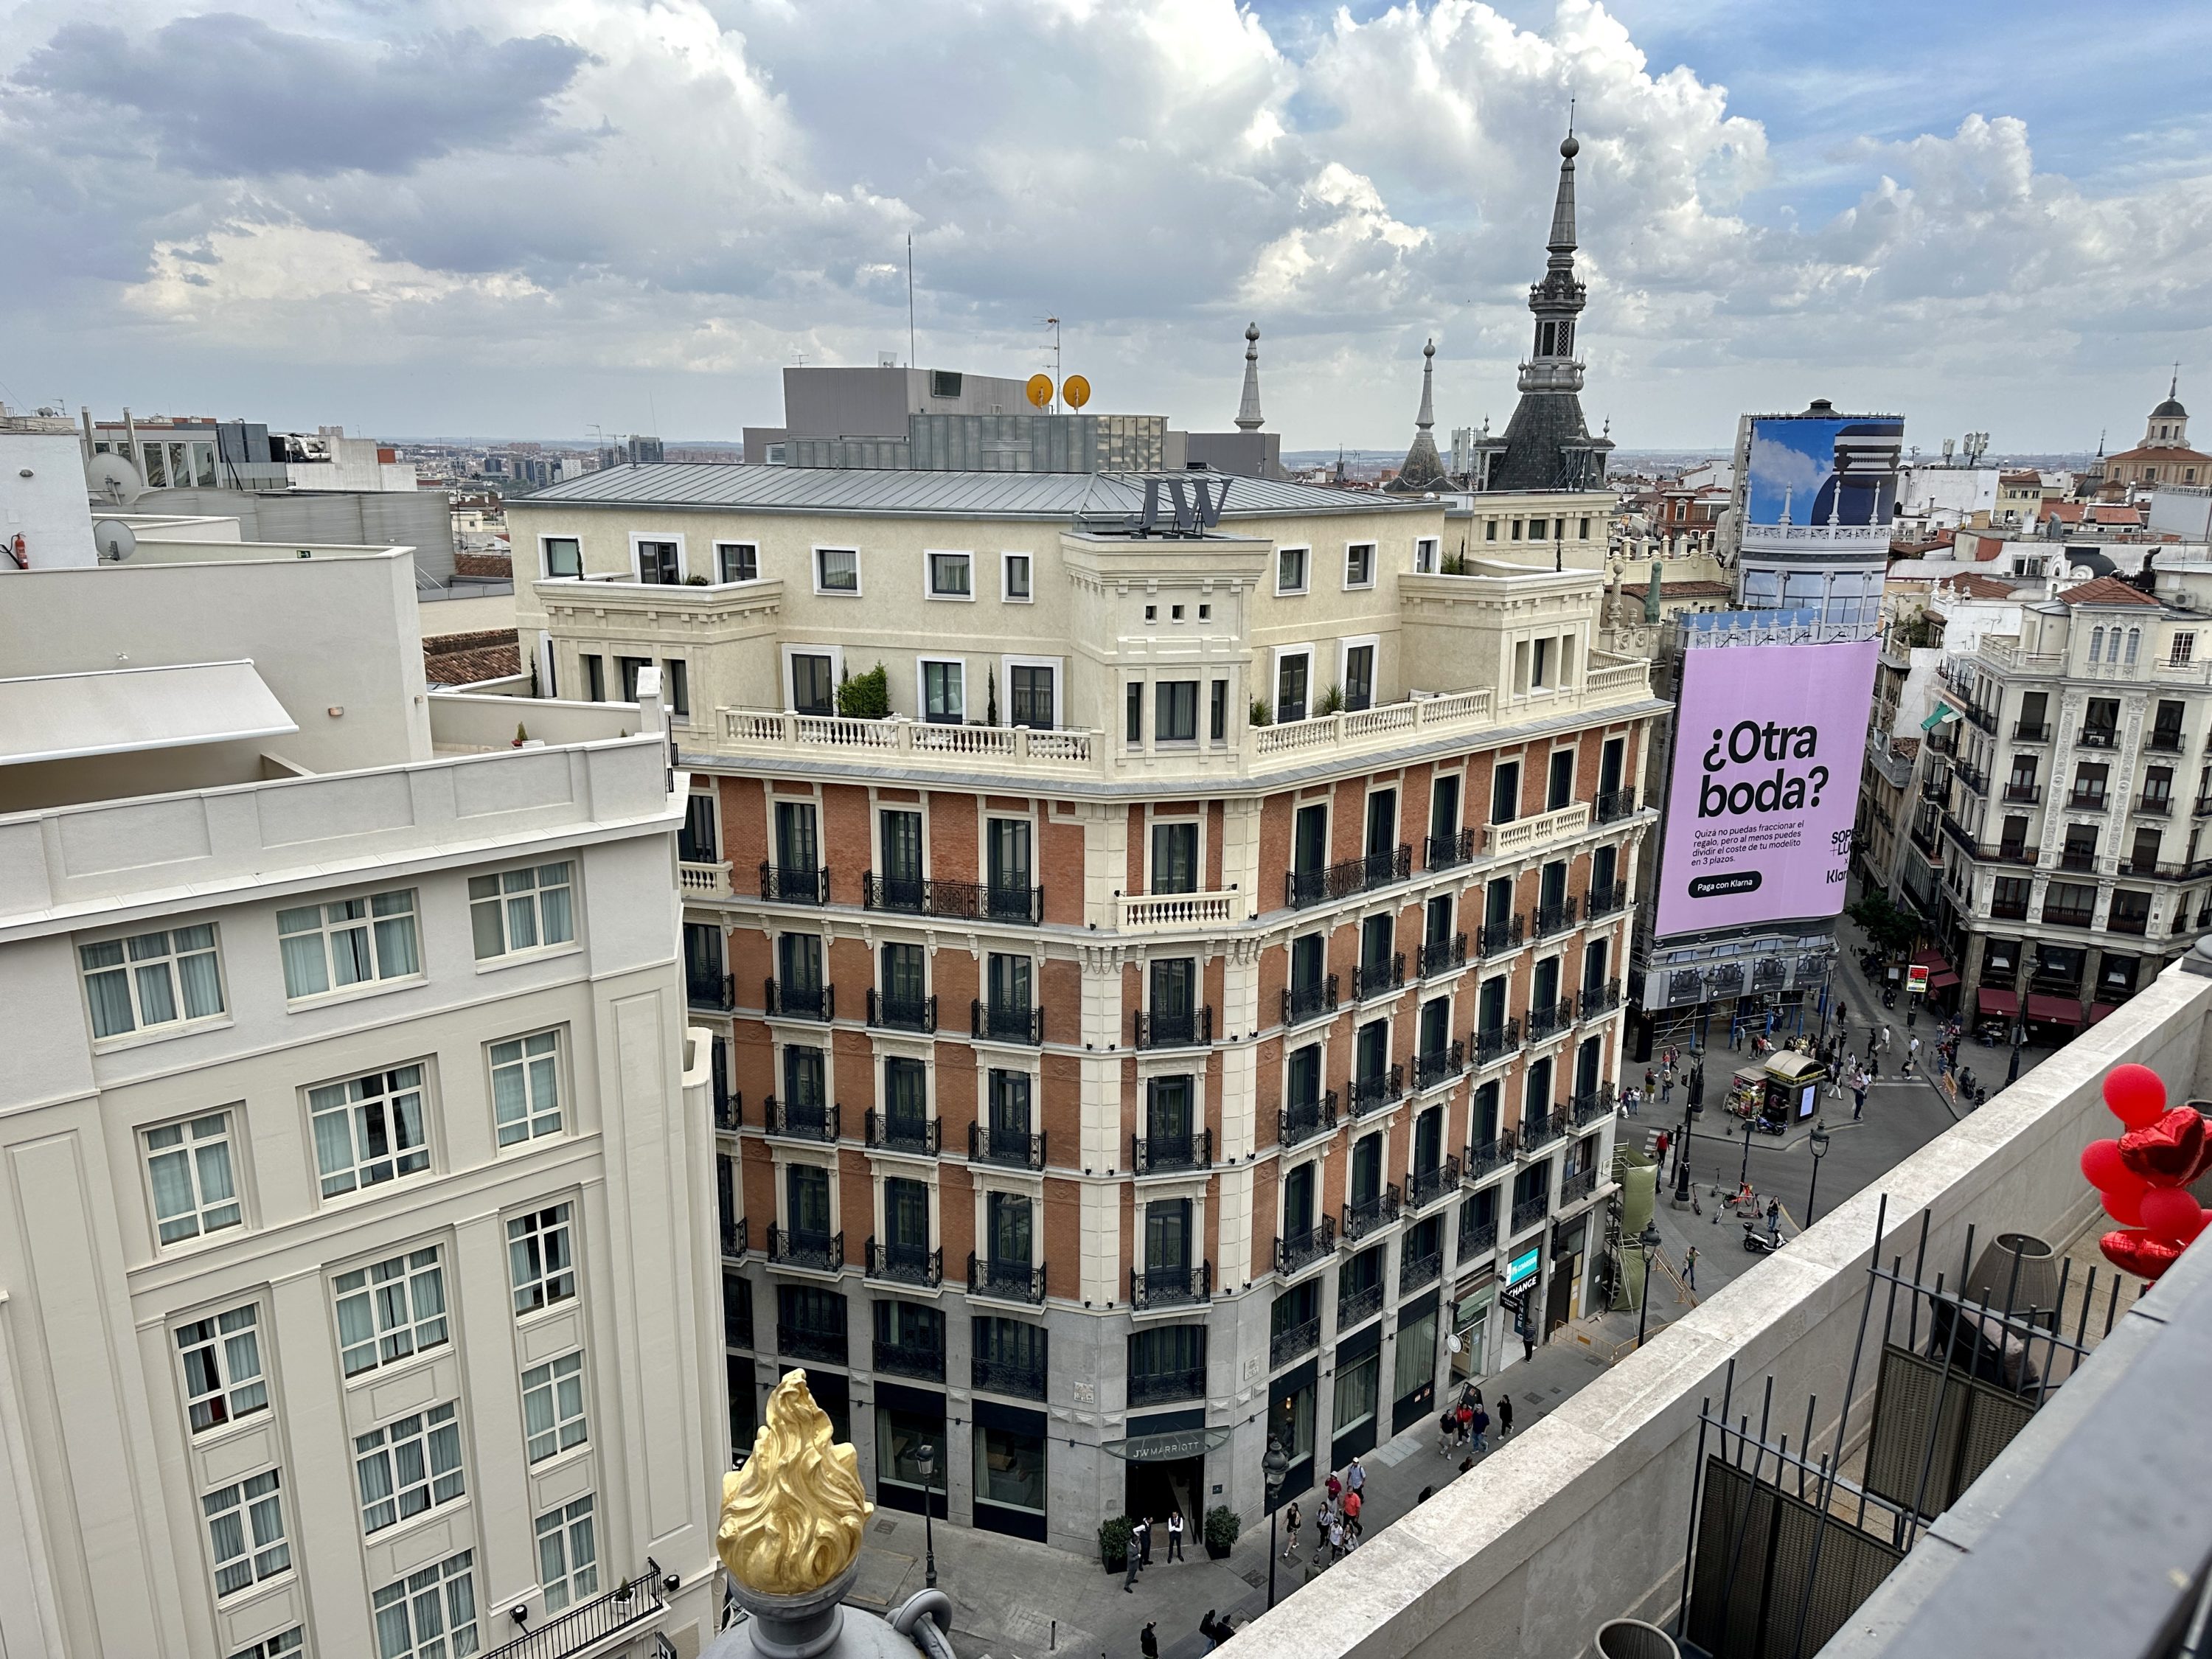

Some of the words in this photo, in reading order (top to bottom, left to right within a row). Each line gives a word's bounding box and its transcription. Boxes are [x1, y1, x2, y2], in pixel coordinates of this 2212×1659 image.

[1123, 479, 1235, 529] JW
[1703, 720, 1818, 772] ¿Otra
[1697, 765, 1829, 818] boda?
[1694, 829, 1717, 839] Quizá
[1729, 825, 1757, 836] puedas
[1759, 821, 1796, 832] fraccionar
[1797, 820, 1804, 828] el
[1692, 847, 1716, 857] dividir
[1717, 846, 1724, 855] el
[1725, 844, 1746, 853] coste
[1747, 843, 1758, 851] de
[1769, 839, 1801, 849] modelito
[1693, 838, 1719, 849] regalo,
[1721, 837, 1739, 846] pero
[1739, 835, 1747, 843] al
[1748, 832, 1773, 841] menos
[1774, 830, 1801, 841] puedes
[1691, 858, 1701, 866] en
[1703, 857, 1708, 865] 3
[1709, 855, 1736, 866] plazos.
[1697, 883, 1714, 892] Paga
[1716, 881, 1729, 889] con
[1730, 879, 1753, 888] Klarna
[1826, 869, 1848, 883] Klar
[1509, 1276, 1537, 1298] CHANGE
[1133, 1449, 1150, 1458] JW
[1150, 1441, 1199, 1455] MARRIOTT
